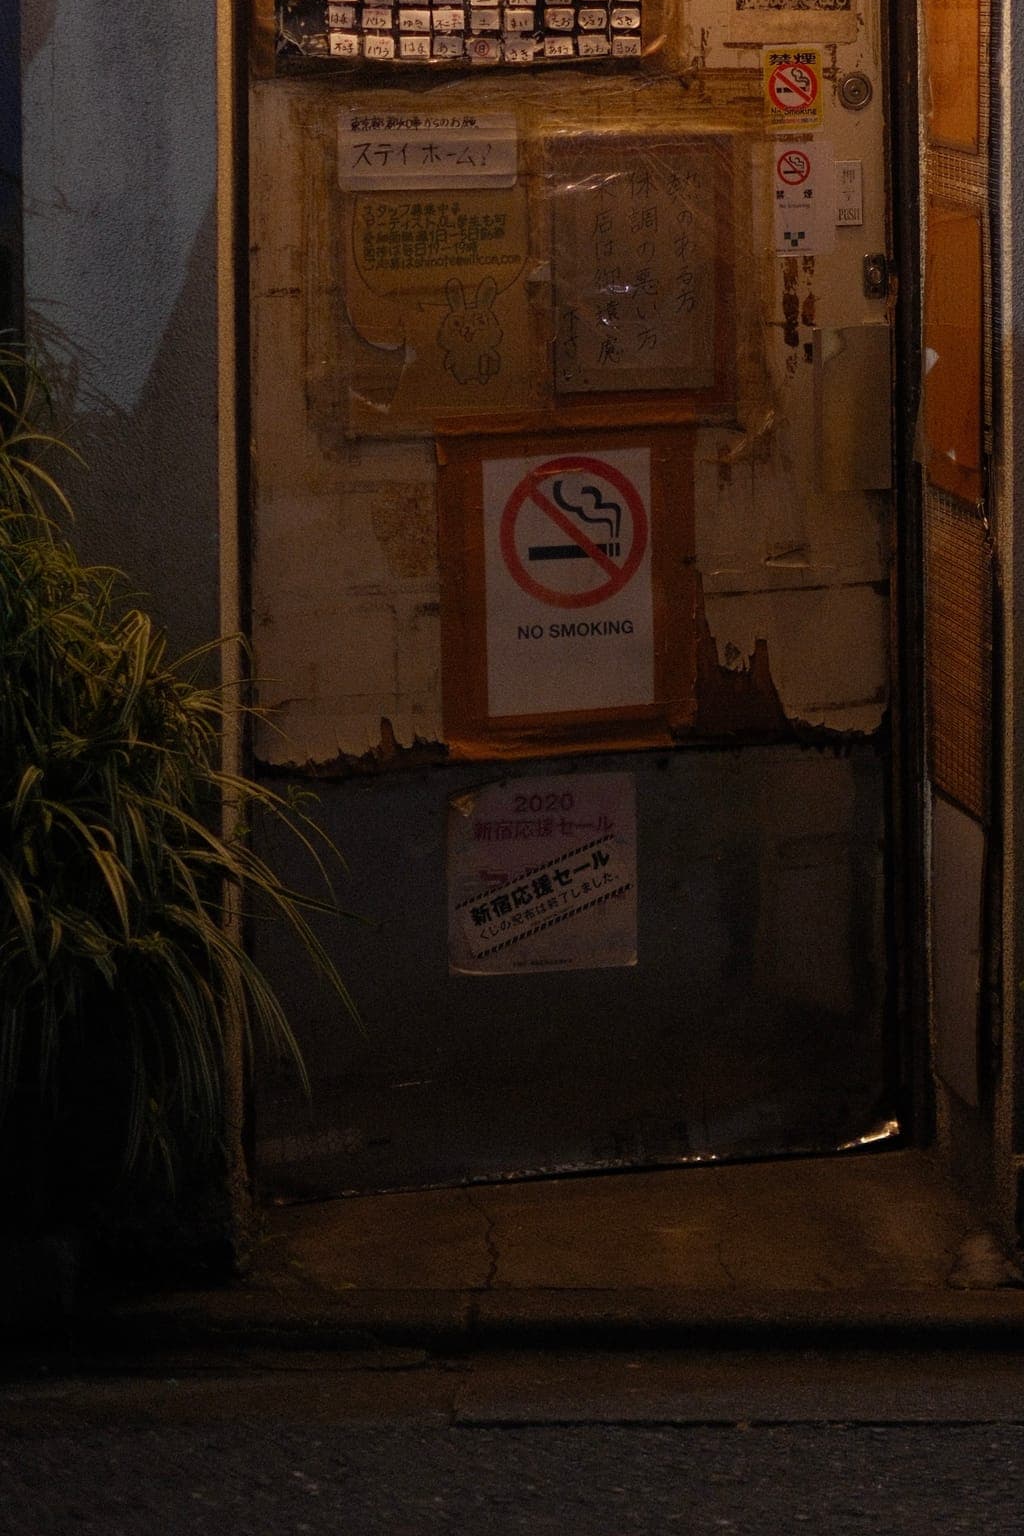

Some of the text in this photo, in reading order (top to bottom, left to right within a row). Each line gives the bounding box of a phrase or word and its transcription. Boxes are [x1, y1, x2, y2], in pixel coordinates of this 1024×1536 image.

[770, 53, 816, 65] 禁煙
[517, 620, 635, 640] NO SMOKING
[514, 793, 575, 814] 2020
[473, 816, 615, 842] 新宿応援セール
[470, 850, 611, 927] 新宿応援セール
